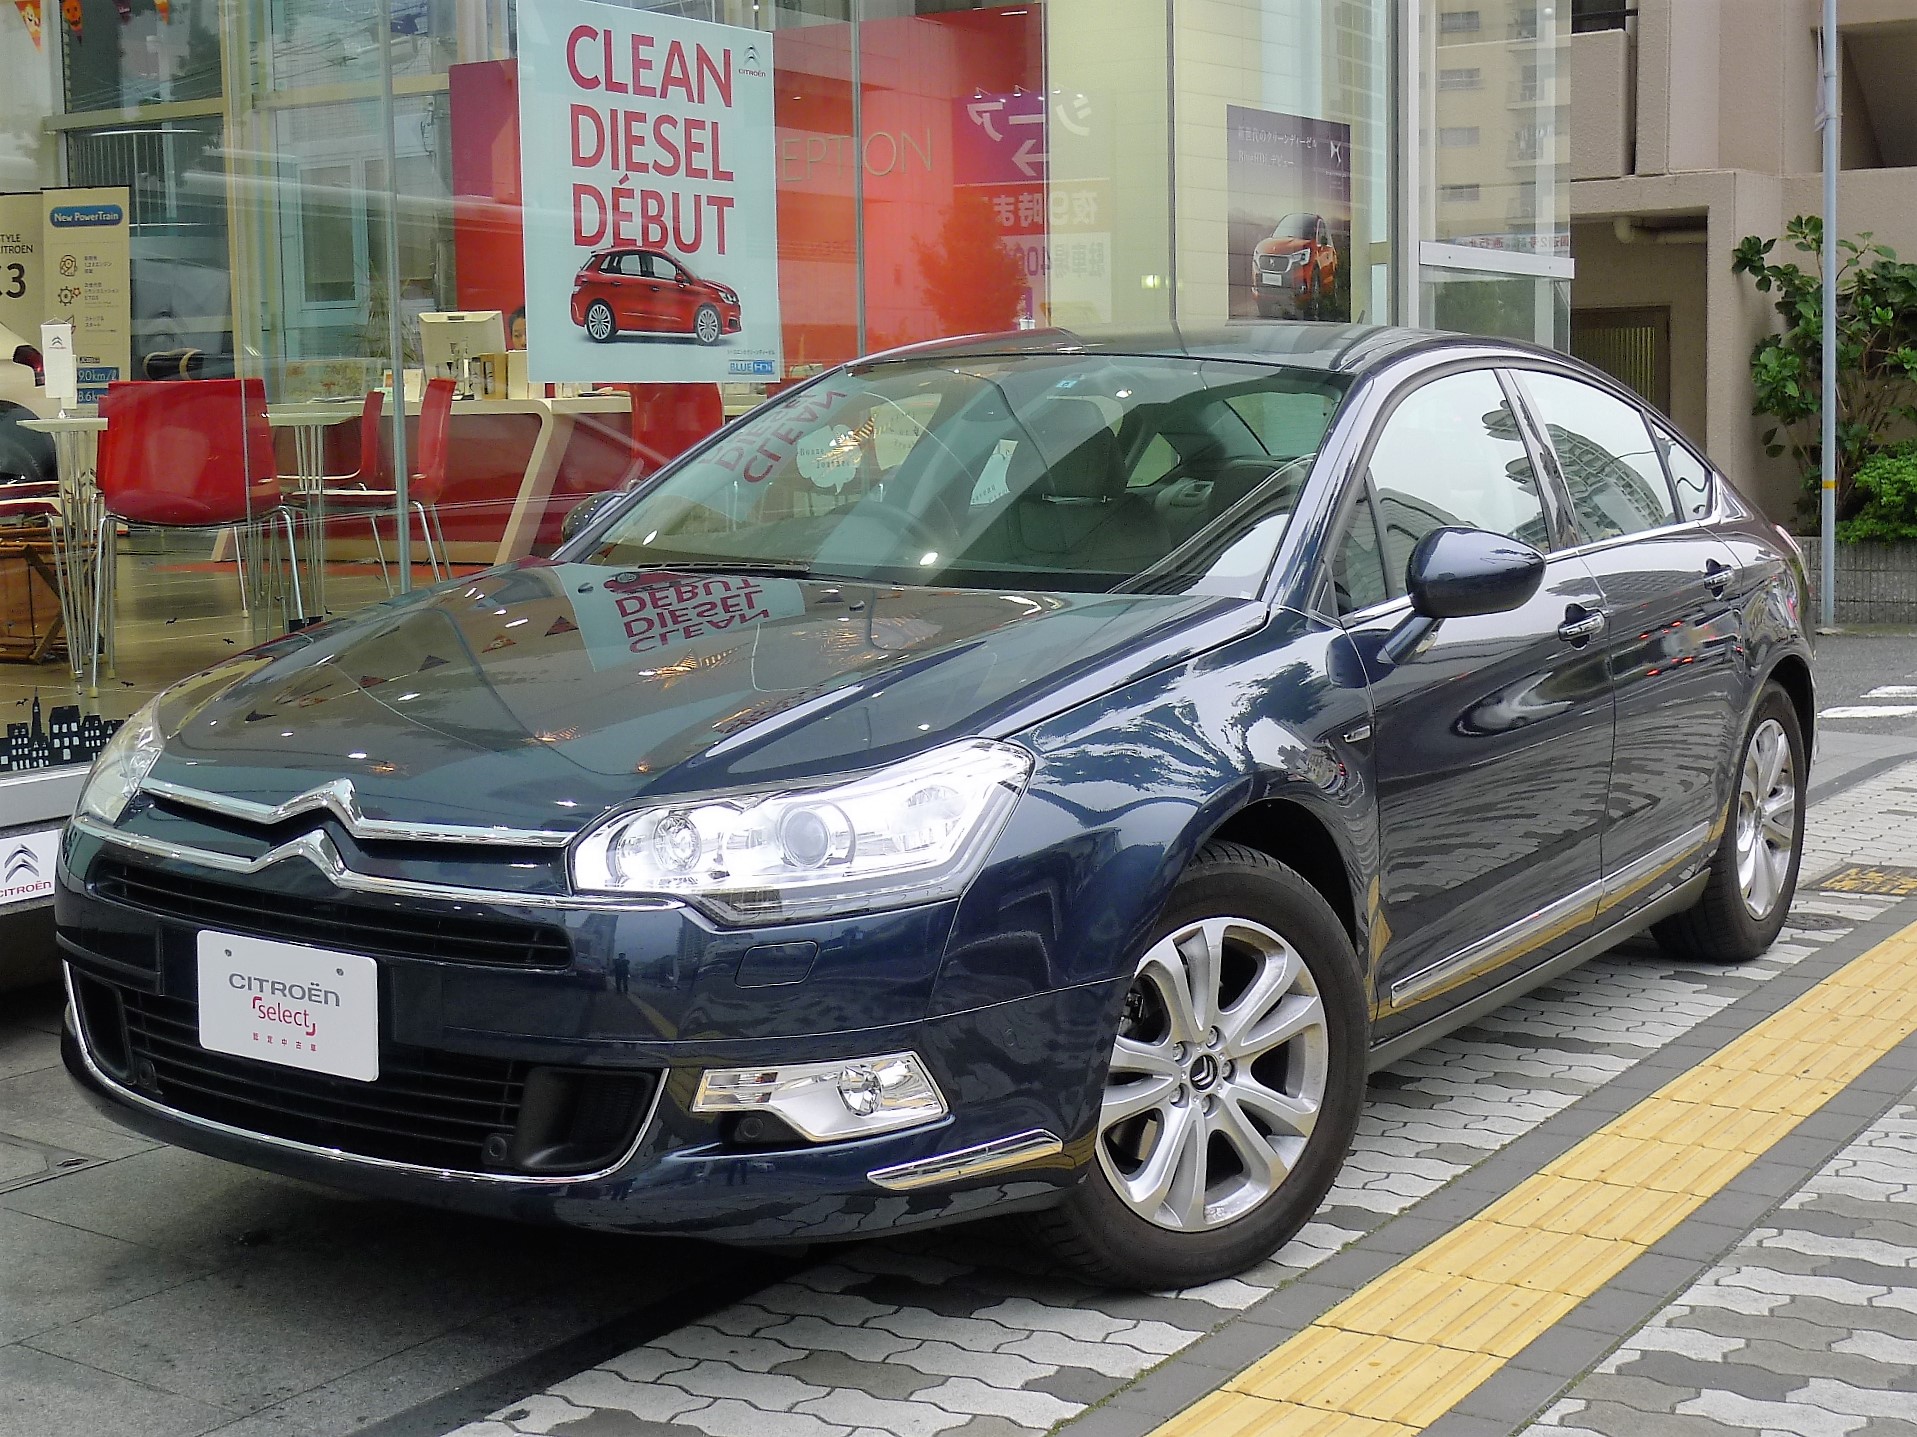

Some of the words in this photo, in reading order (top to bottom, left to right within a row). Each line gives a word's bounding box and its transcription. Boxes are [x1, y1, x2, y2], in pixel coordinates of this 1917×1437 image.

[566, 24, 732, 108] CLEAN
[570, 103, 735, 182] DIESEL
[54, 213, 73, 222] New
[75, 211, 119, 221] PowerTrain
[572, 173, 735, 255] DÉBUT
[730, 362, 752, 372] BLUE
[228, 973, 340, 1007] CITROËN
[258, 1002, 310, 1028] select
